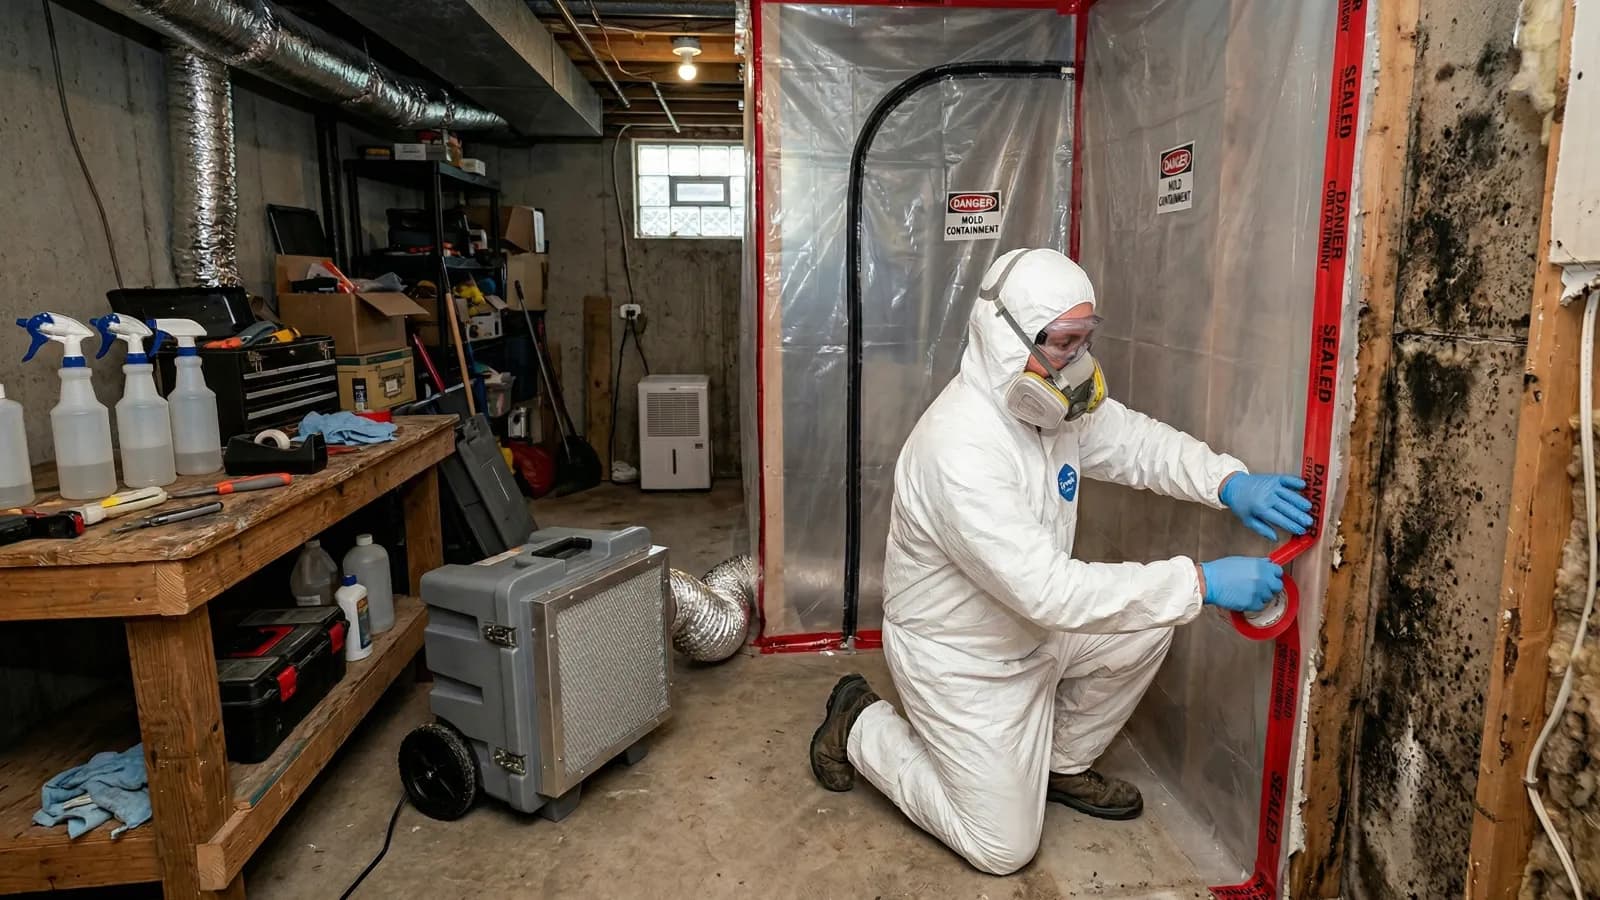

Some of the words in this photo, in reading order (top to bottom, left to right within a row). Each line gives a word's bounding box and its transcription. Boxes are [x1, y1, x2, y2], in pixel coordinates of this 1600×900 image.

[1339, 64, 1357, 139] SEALED
[953, 197, 994, 209] DANGER
[961, 215, 984, 225] MOLD
[946, 224, 999, 236] CONTAINMENT
[1318, 324, 1337, 403] SEALED
[1264, 771, 1283, 844] SEALED
